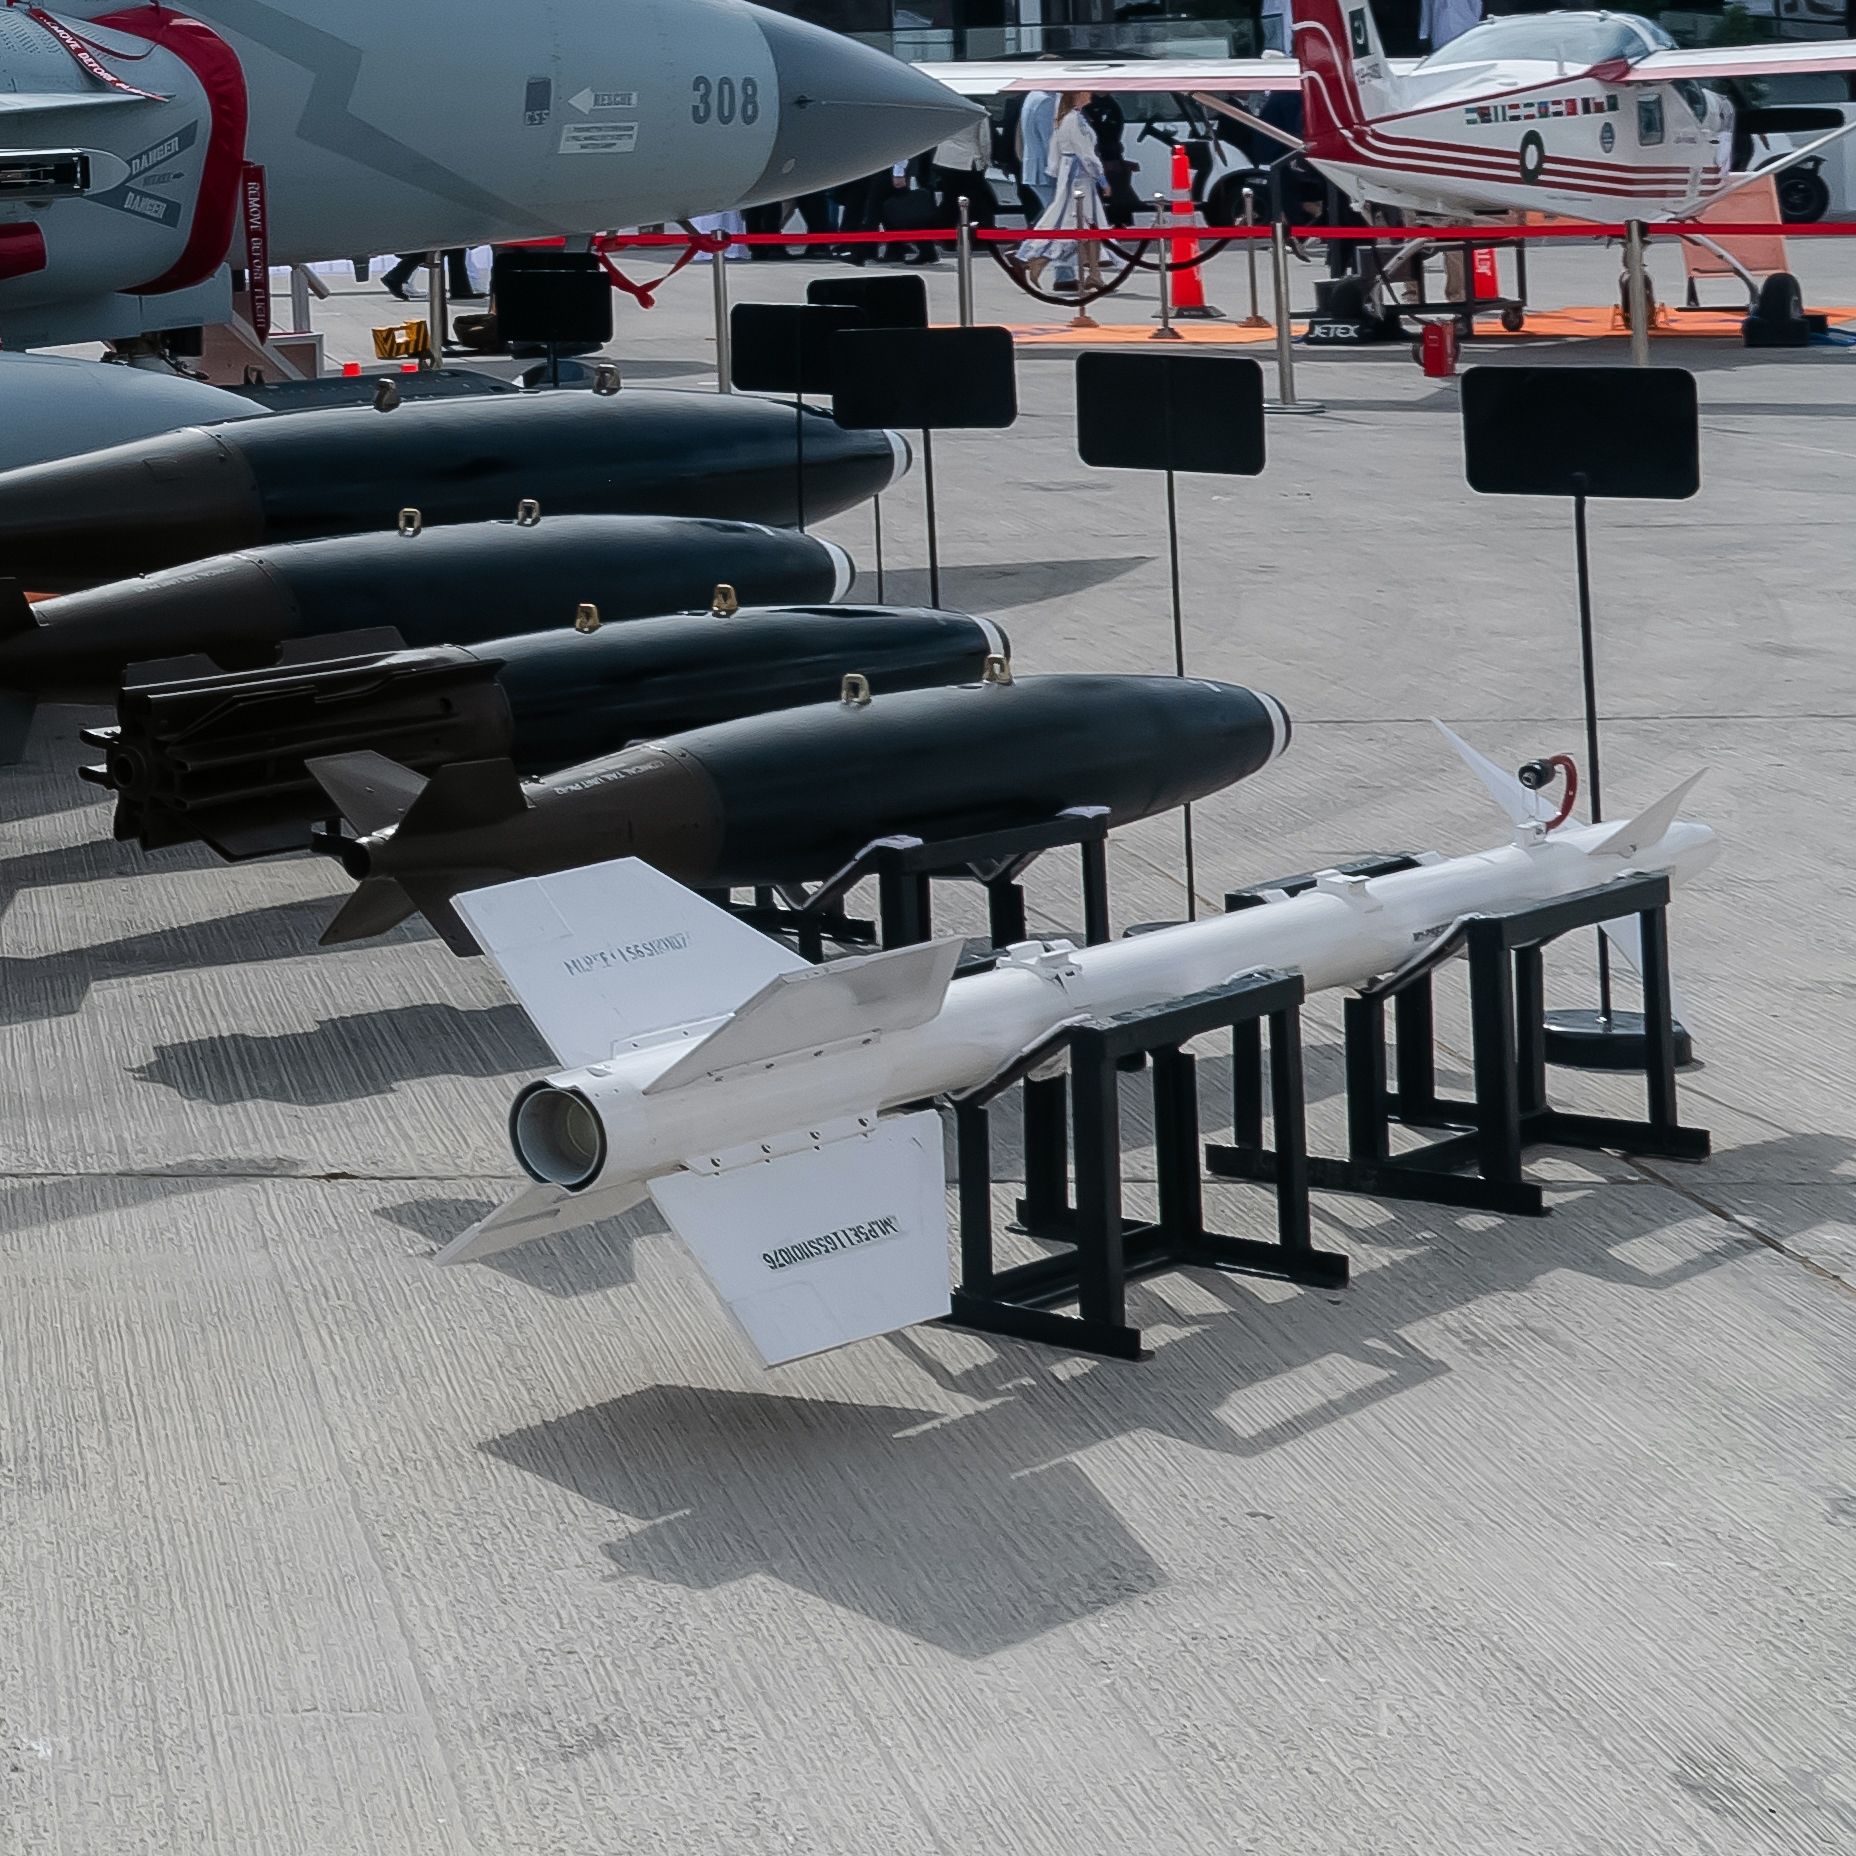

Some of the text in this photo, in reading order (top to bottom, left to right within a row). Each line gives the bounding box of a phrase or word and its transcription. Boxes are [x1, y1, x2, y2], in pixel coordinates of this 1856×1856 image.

[691, 75, 760, 125] 308
[131, 137, 179, 175] DANGER
[247, 181, 262, 232] REMOVE
[1308, 324, 1360, 338] JETEX
